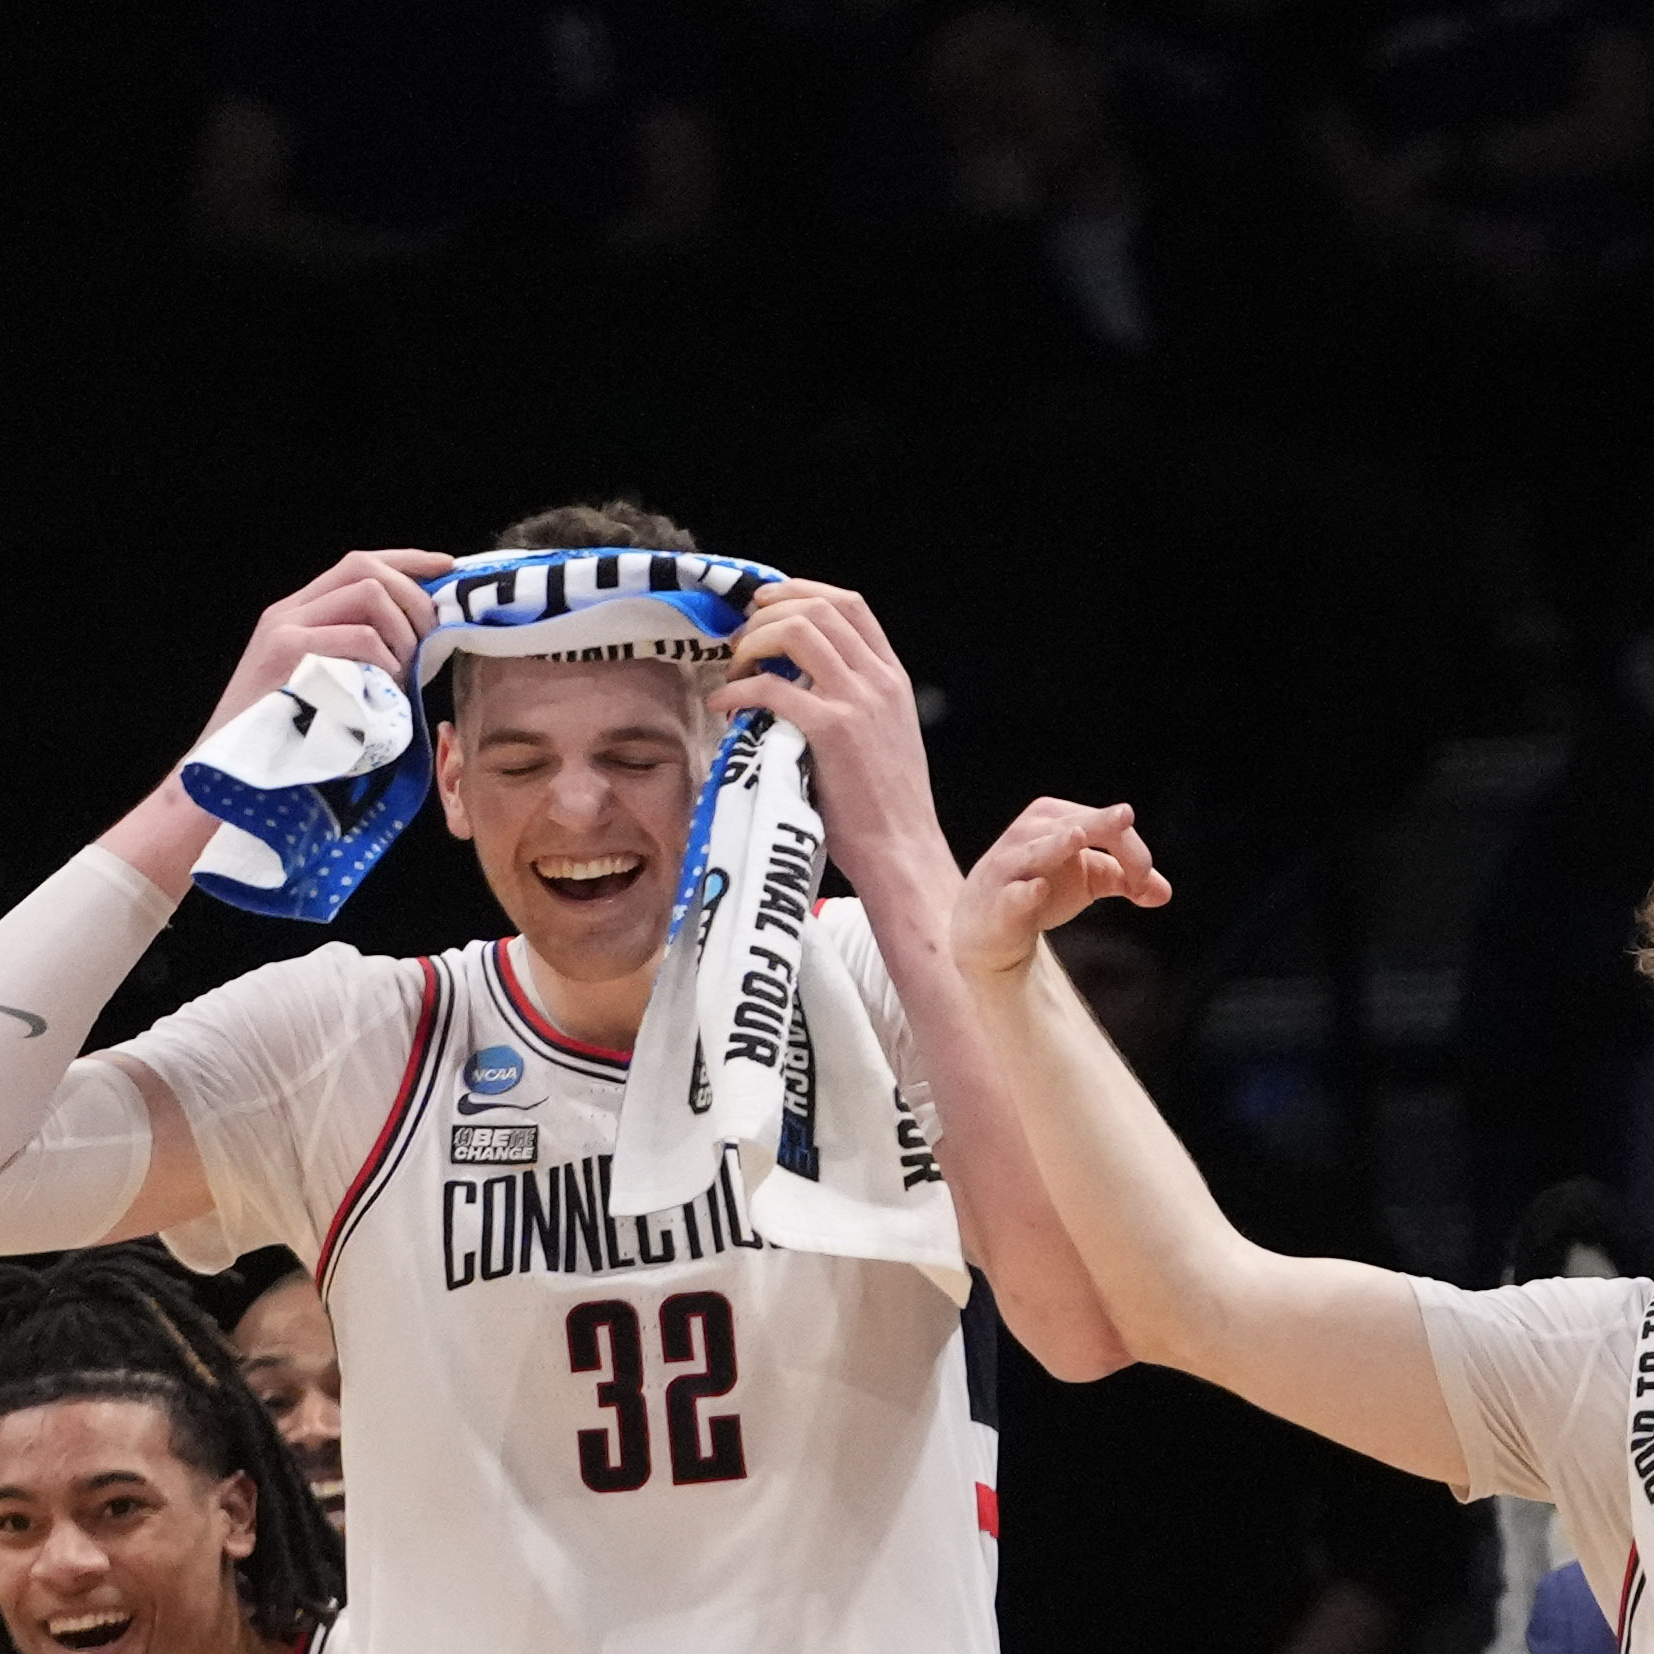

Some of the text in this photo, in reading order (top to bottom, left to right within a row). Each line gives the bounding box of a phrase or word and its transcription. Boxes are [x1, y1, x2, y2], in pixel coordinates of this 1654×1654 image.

[724, 822, 820, 1068] FINAL FOUR
[473, 1066, 518, 1082] NCAA
[471, 1127, 511, 1148] BE
[453, 1146, 534, 1161] CHANGE
[565, 1290, 748, 1494] 32
